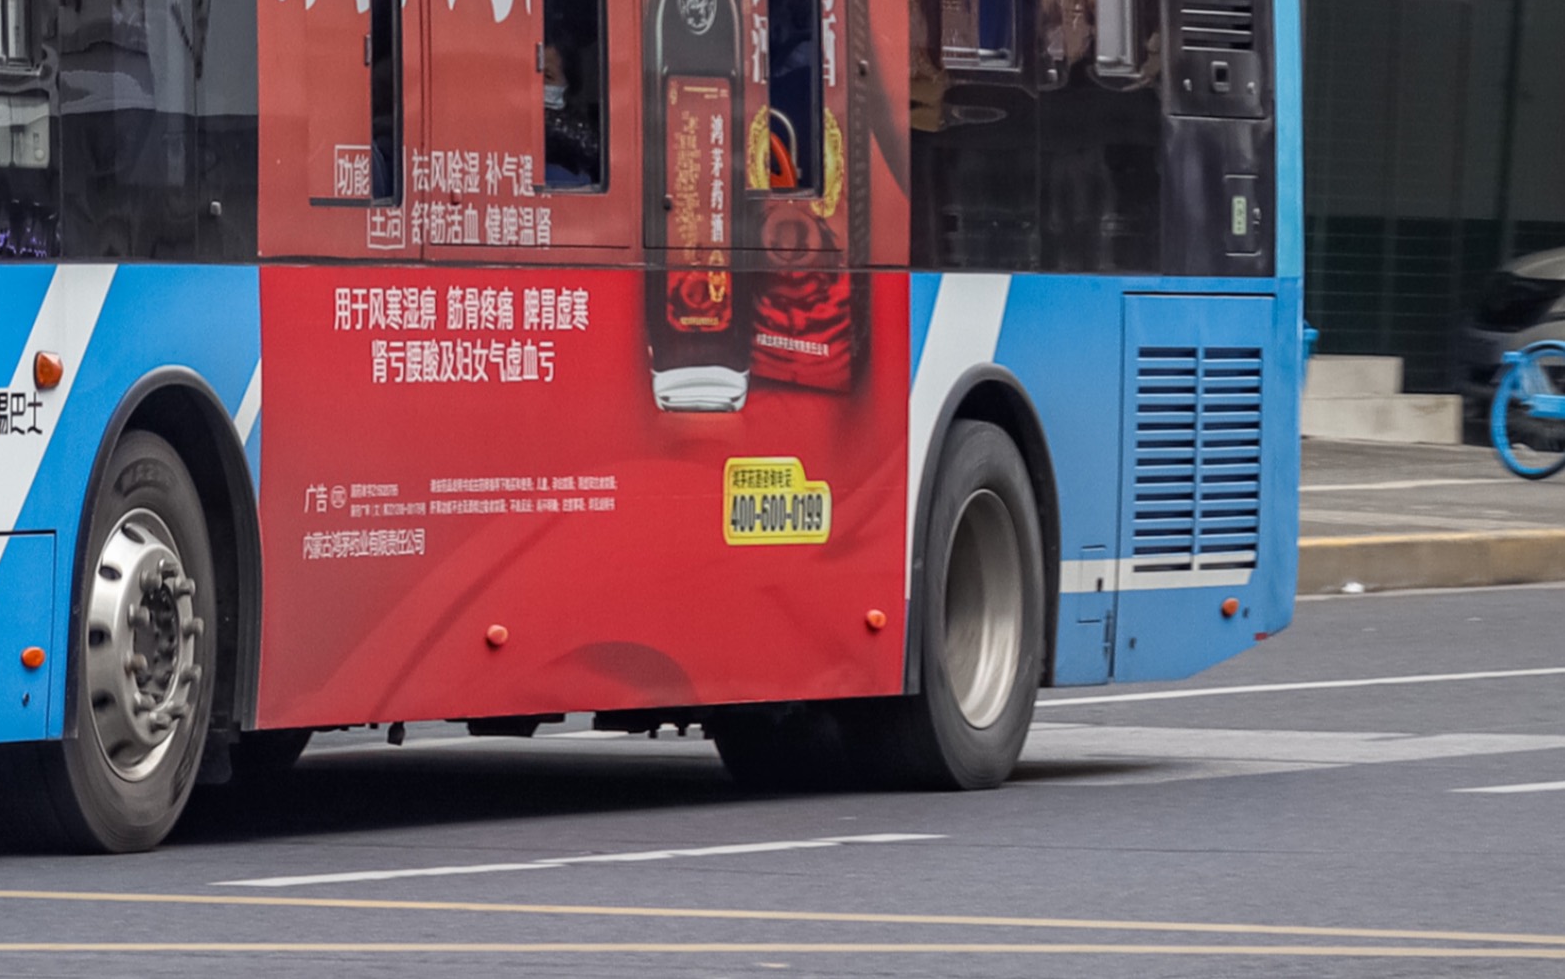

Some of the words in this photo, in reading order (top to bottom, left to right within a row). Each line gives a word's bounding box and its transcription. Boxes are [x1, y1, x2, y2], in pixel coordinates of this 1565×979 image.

[485, 152, 552, 198] 补气通
[411, 201, 480, 245] 舒筋活血
[304, 483, 328, 513] 广告
